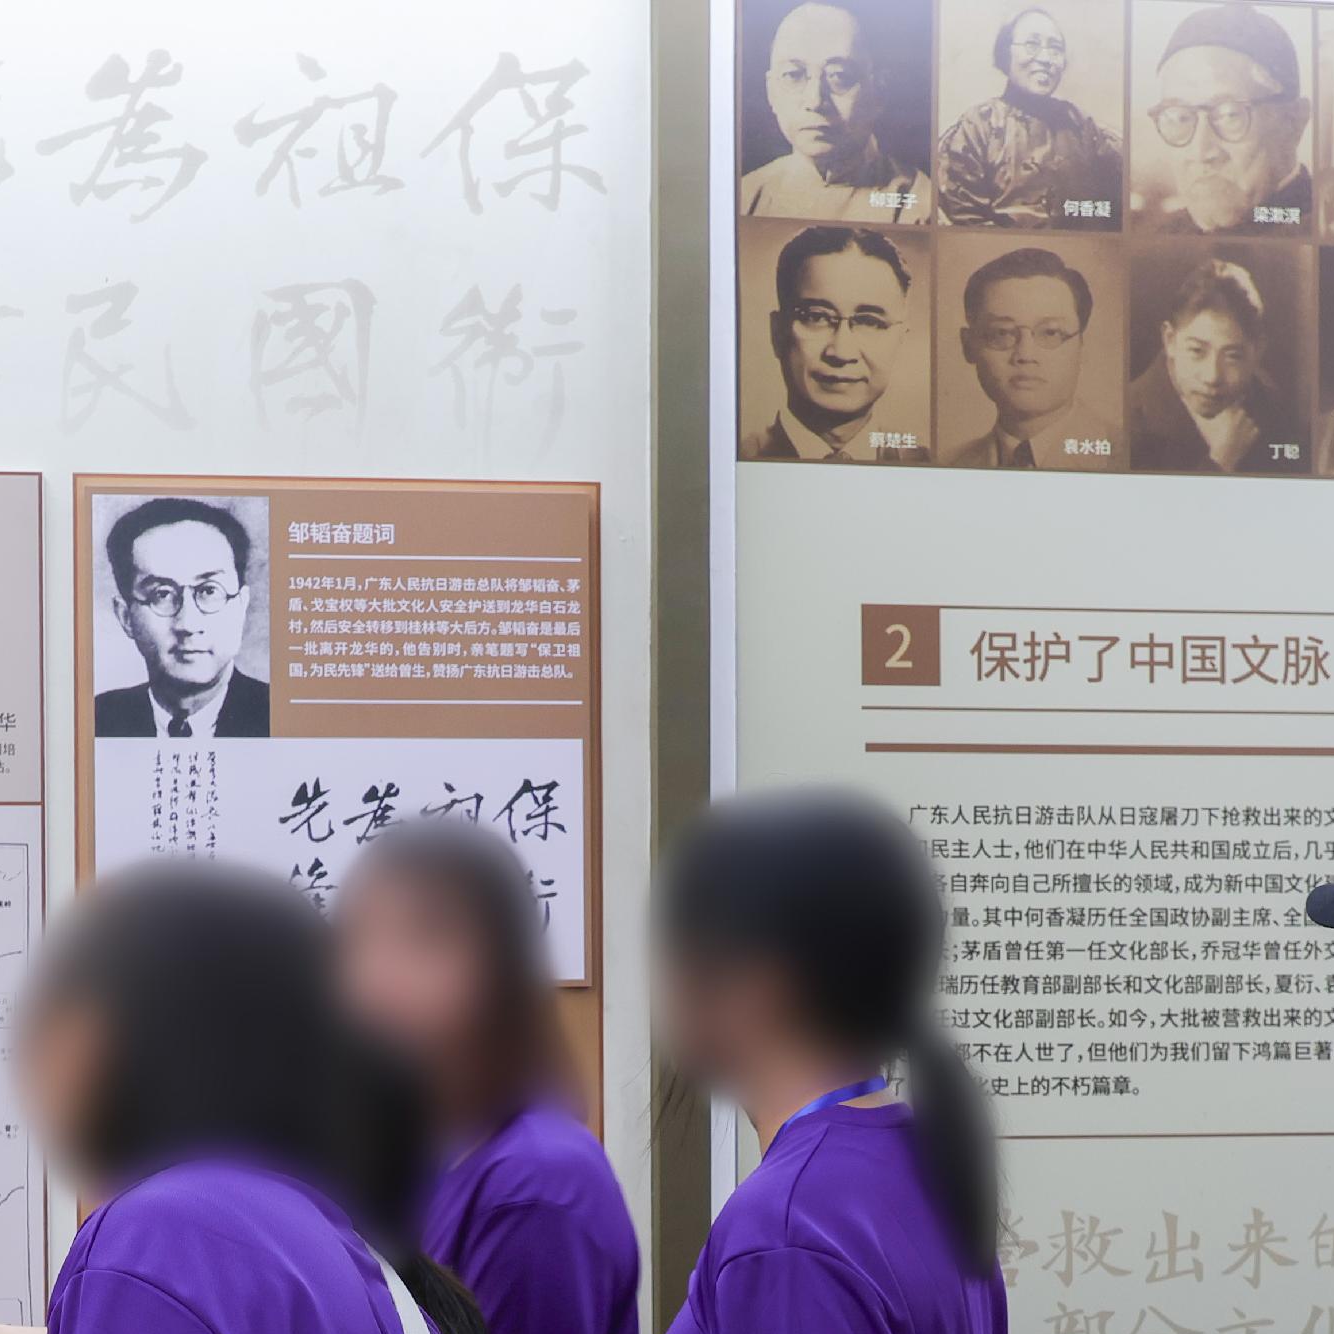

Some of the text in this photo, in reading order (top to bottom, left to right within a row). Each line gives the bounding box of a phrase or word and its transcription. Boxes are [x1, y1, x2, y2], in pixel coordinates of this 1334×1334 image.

[1064, 199, 1112, 217] 何香凝
[868, 431, 918, 449] 蔡楚生
[1064, 439, 1112, 455] 袁水拍
[1269, 443, 1300, 460] 丁聪
[288, 521, 395, 545] 邹韬奋题词
[288, 597, 581, 614] 盾、戈宝权等大批文化人安全护送到龙华白石龙
[884, 623, 913, 669] 2
[969, 630, 1332, 687] 保护了中国文脉
